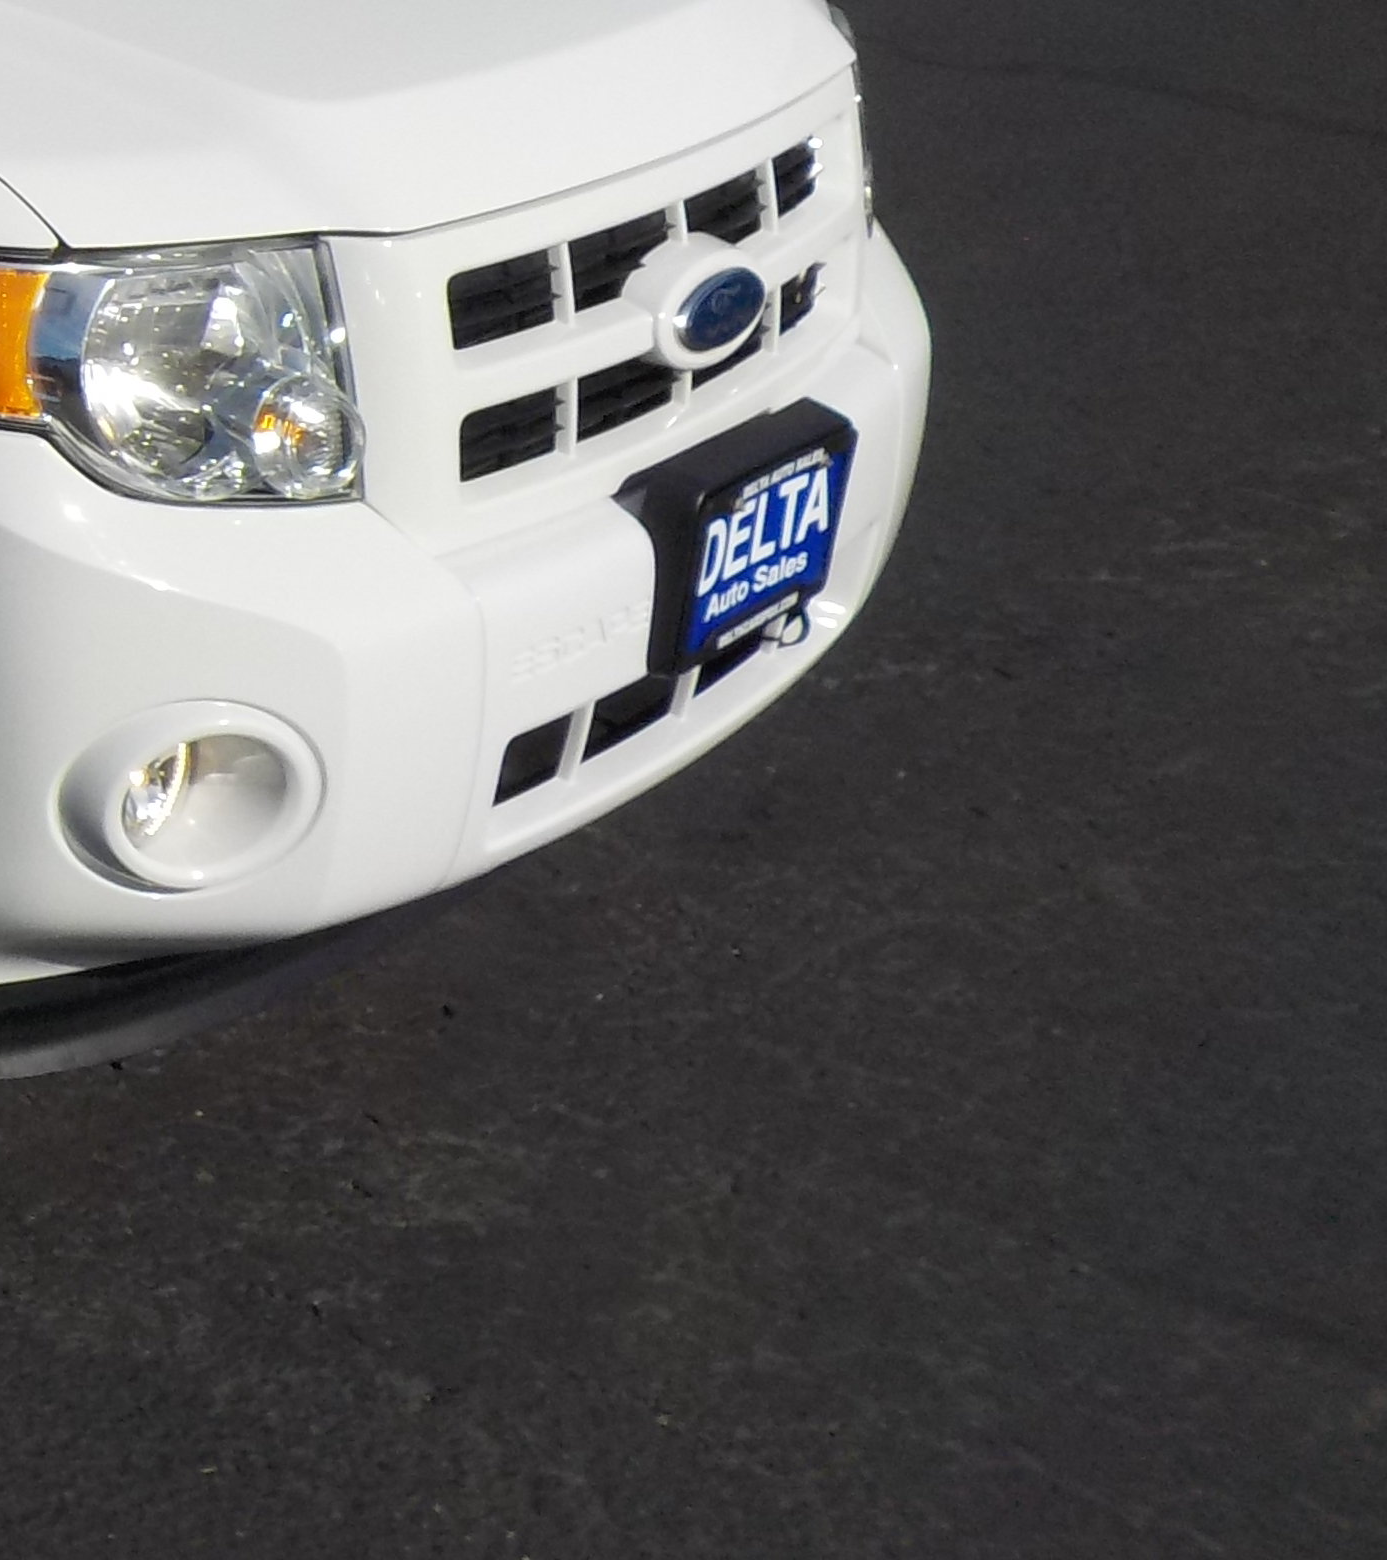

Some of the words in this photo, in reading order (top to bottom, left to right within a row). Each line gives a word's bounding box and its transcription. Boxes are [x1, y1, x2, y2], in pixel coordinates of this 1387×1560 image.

[696, 466, 829, 598] DELTA
[702, 580, 750, 624] Auto
[751, 550, 809, 594] Sales
